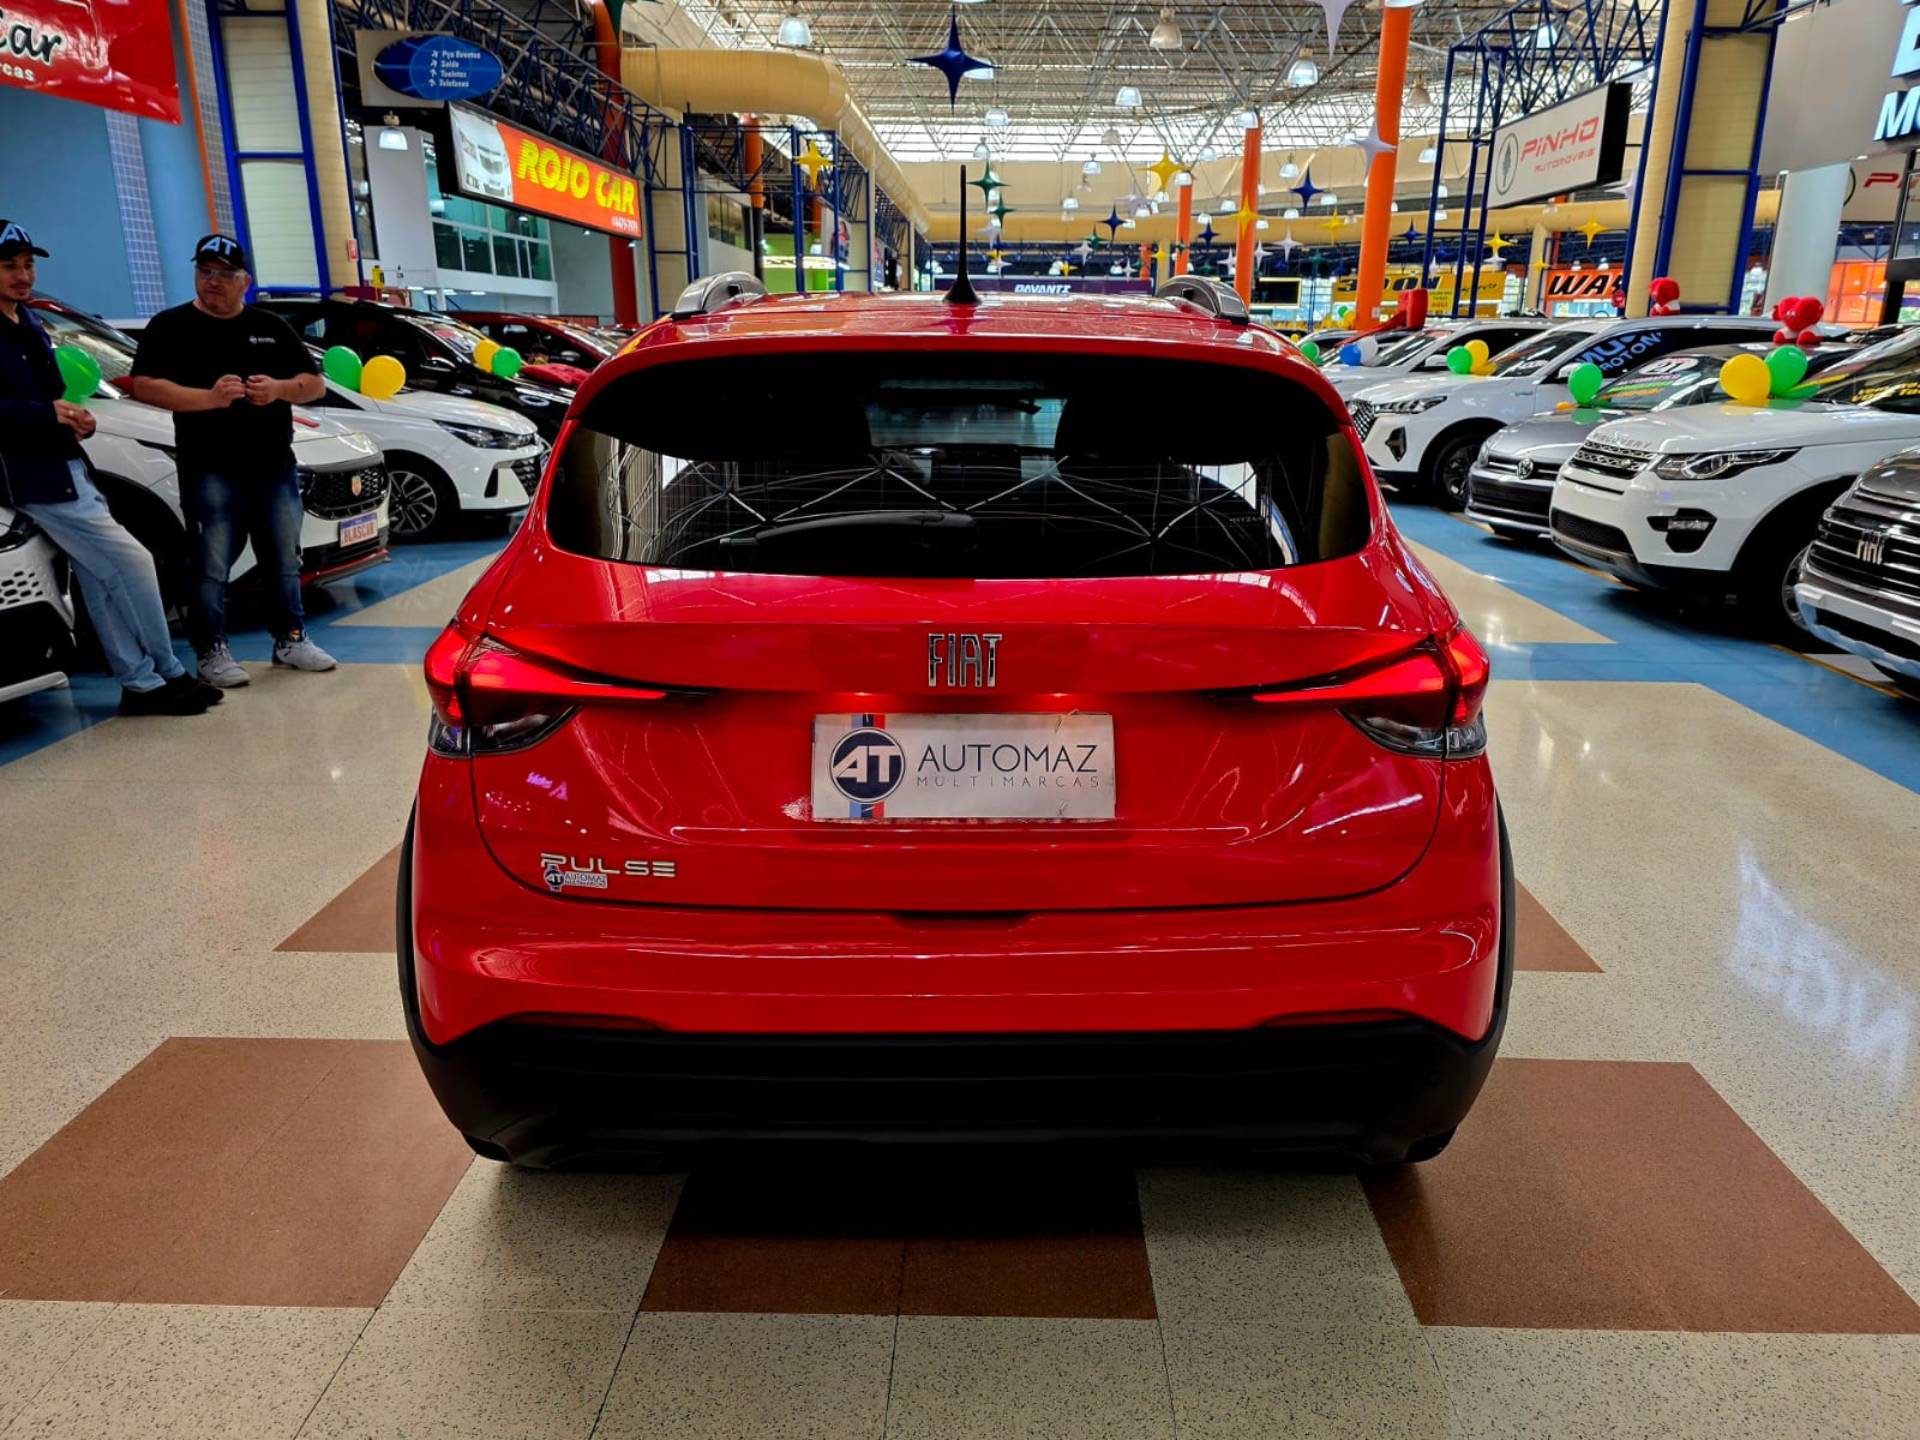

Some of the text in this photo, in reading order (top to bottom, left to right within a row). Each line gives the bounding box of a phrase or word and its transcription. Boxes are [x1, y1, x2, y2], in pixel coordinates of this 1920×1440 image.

[1520, 116, 1599, 162] PINHO
[516, 138, 636, 216] ROJO CAR
[200, 236, 237, 255] AT
[928, 633, 1003, 687] FIAT
[832, 744, 1099, 784] AT AUTOMAZ
[916, 775, 1099, 788] MULTIMARCAS
[540, 853, 676, 877] PULSE
